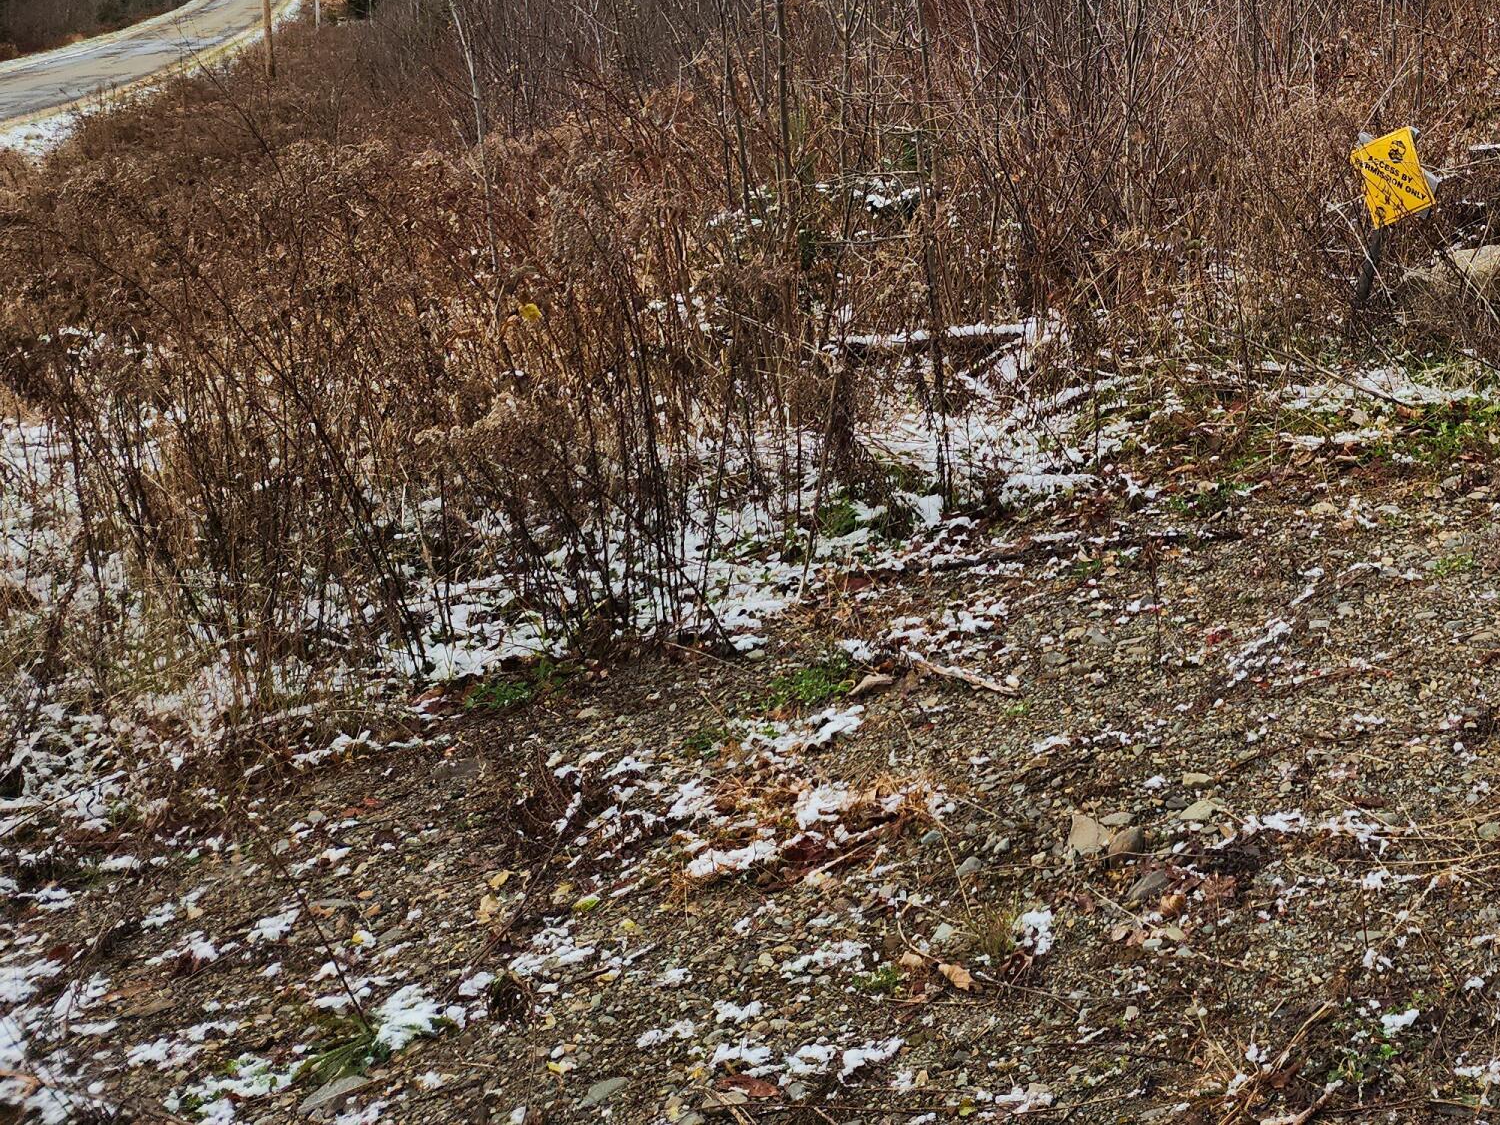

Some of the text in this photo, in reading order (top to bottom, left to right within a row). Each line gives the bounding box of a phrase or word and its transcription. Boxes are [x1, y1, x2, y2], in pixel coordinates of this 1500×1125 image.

[1368, 156, 1413, 183] ACCESS BY
[1405, 186, 1426, 200] ONLY
